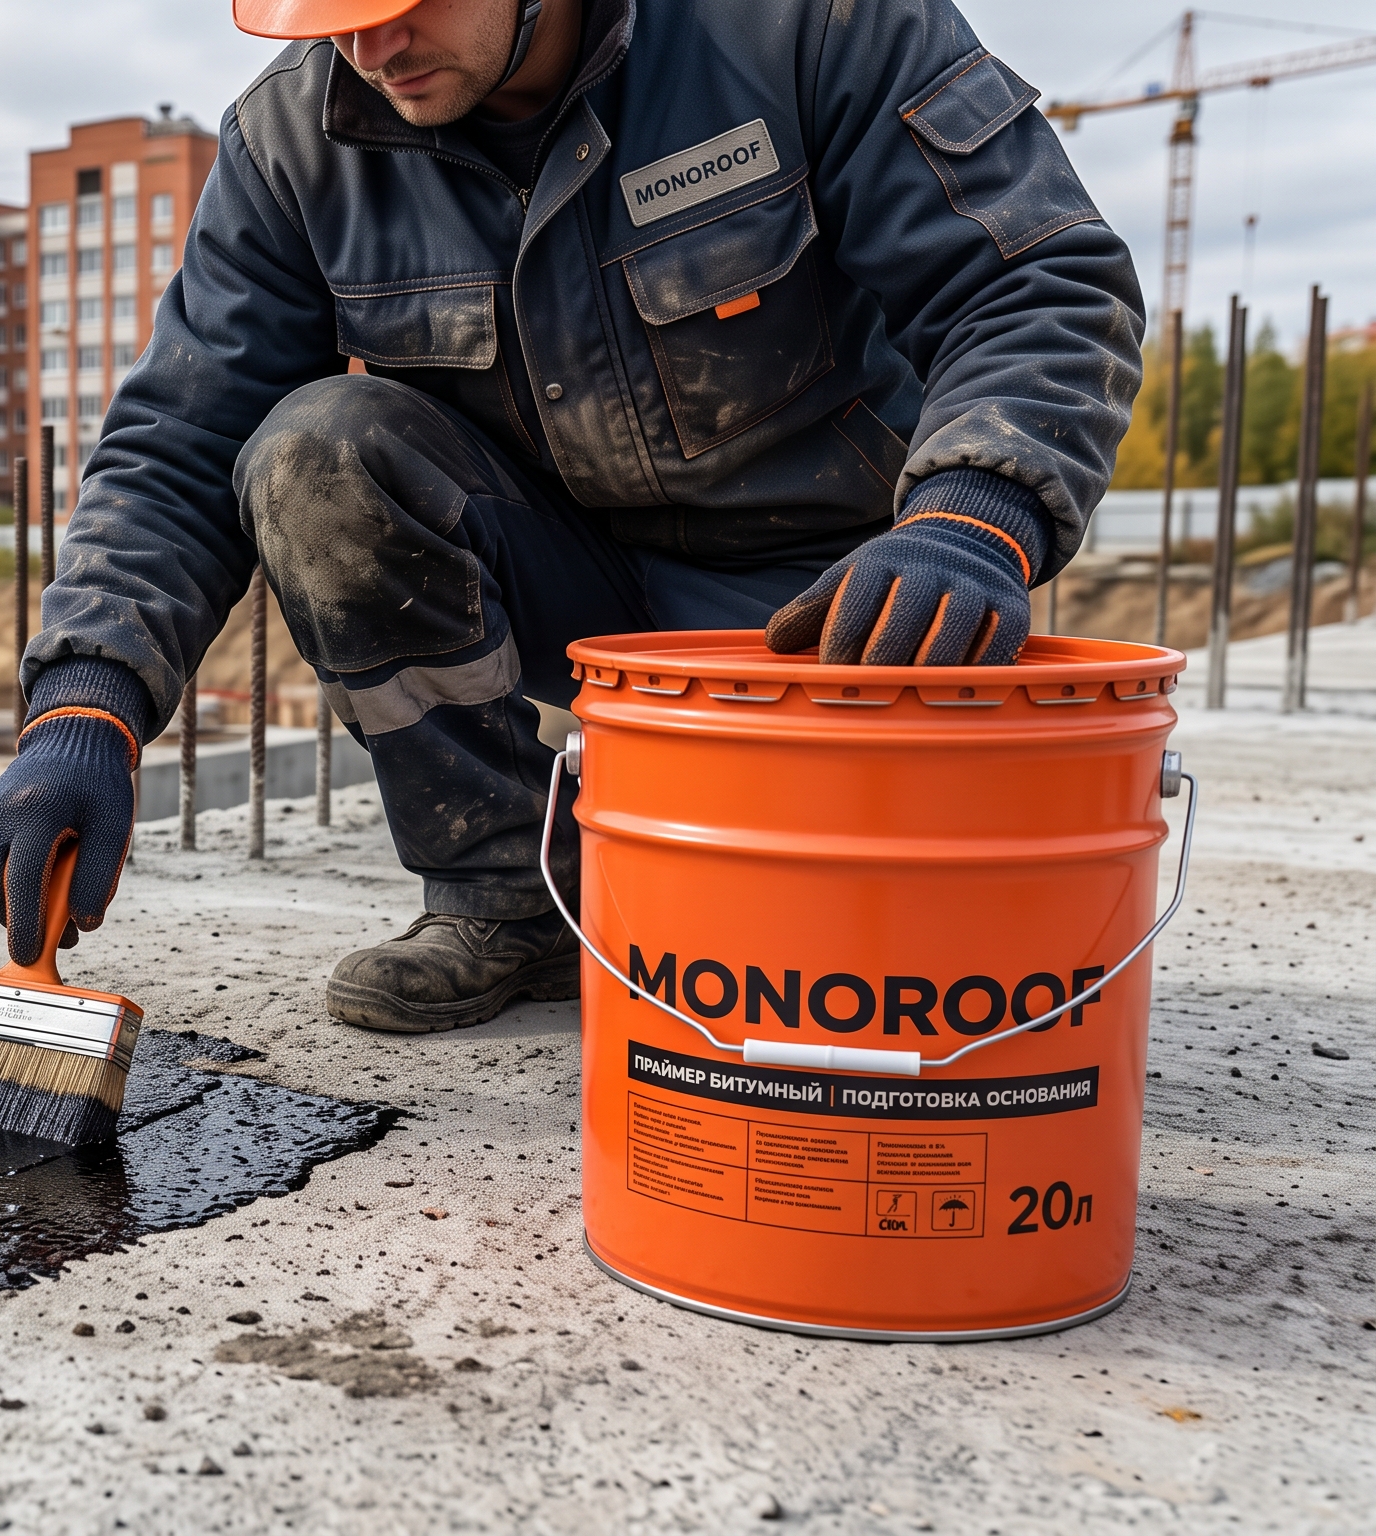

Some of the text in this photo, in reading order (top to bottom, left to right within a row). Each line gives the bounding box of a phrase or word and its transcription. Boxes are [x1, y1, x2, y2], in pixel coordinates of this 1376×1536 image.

[634, 140, 761, 206] MONOROOF
[629, 943, 1105, 1036] MONOROOF
[634, 1054, 1091, 1110] ПРАЙМЕР БИТУМНЫЙ ПОДГОТОВКА ОСНОВАНИЯ
[1007, 1181, 1093, 1235] 20л
